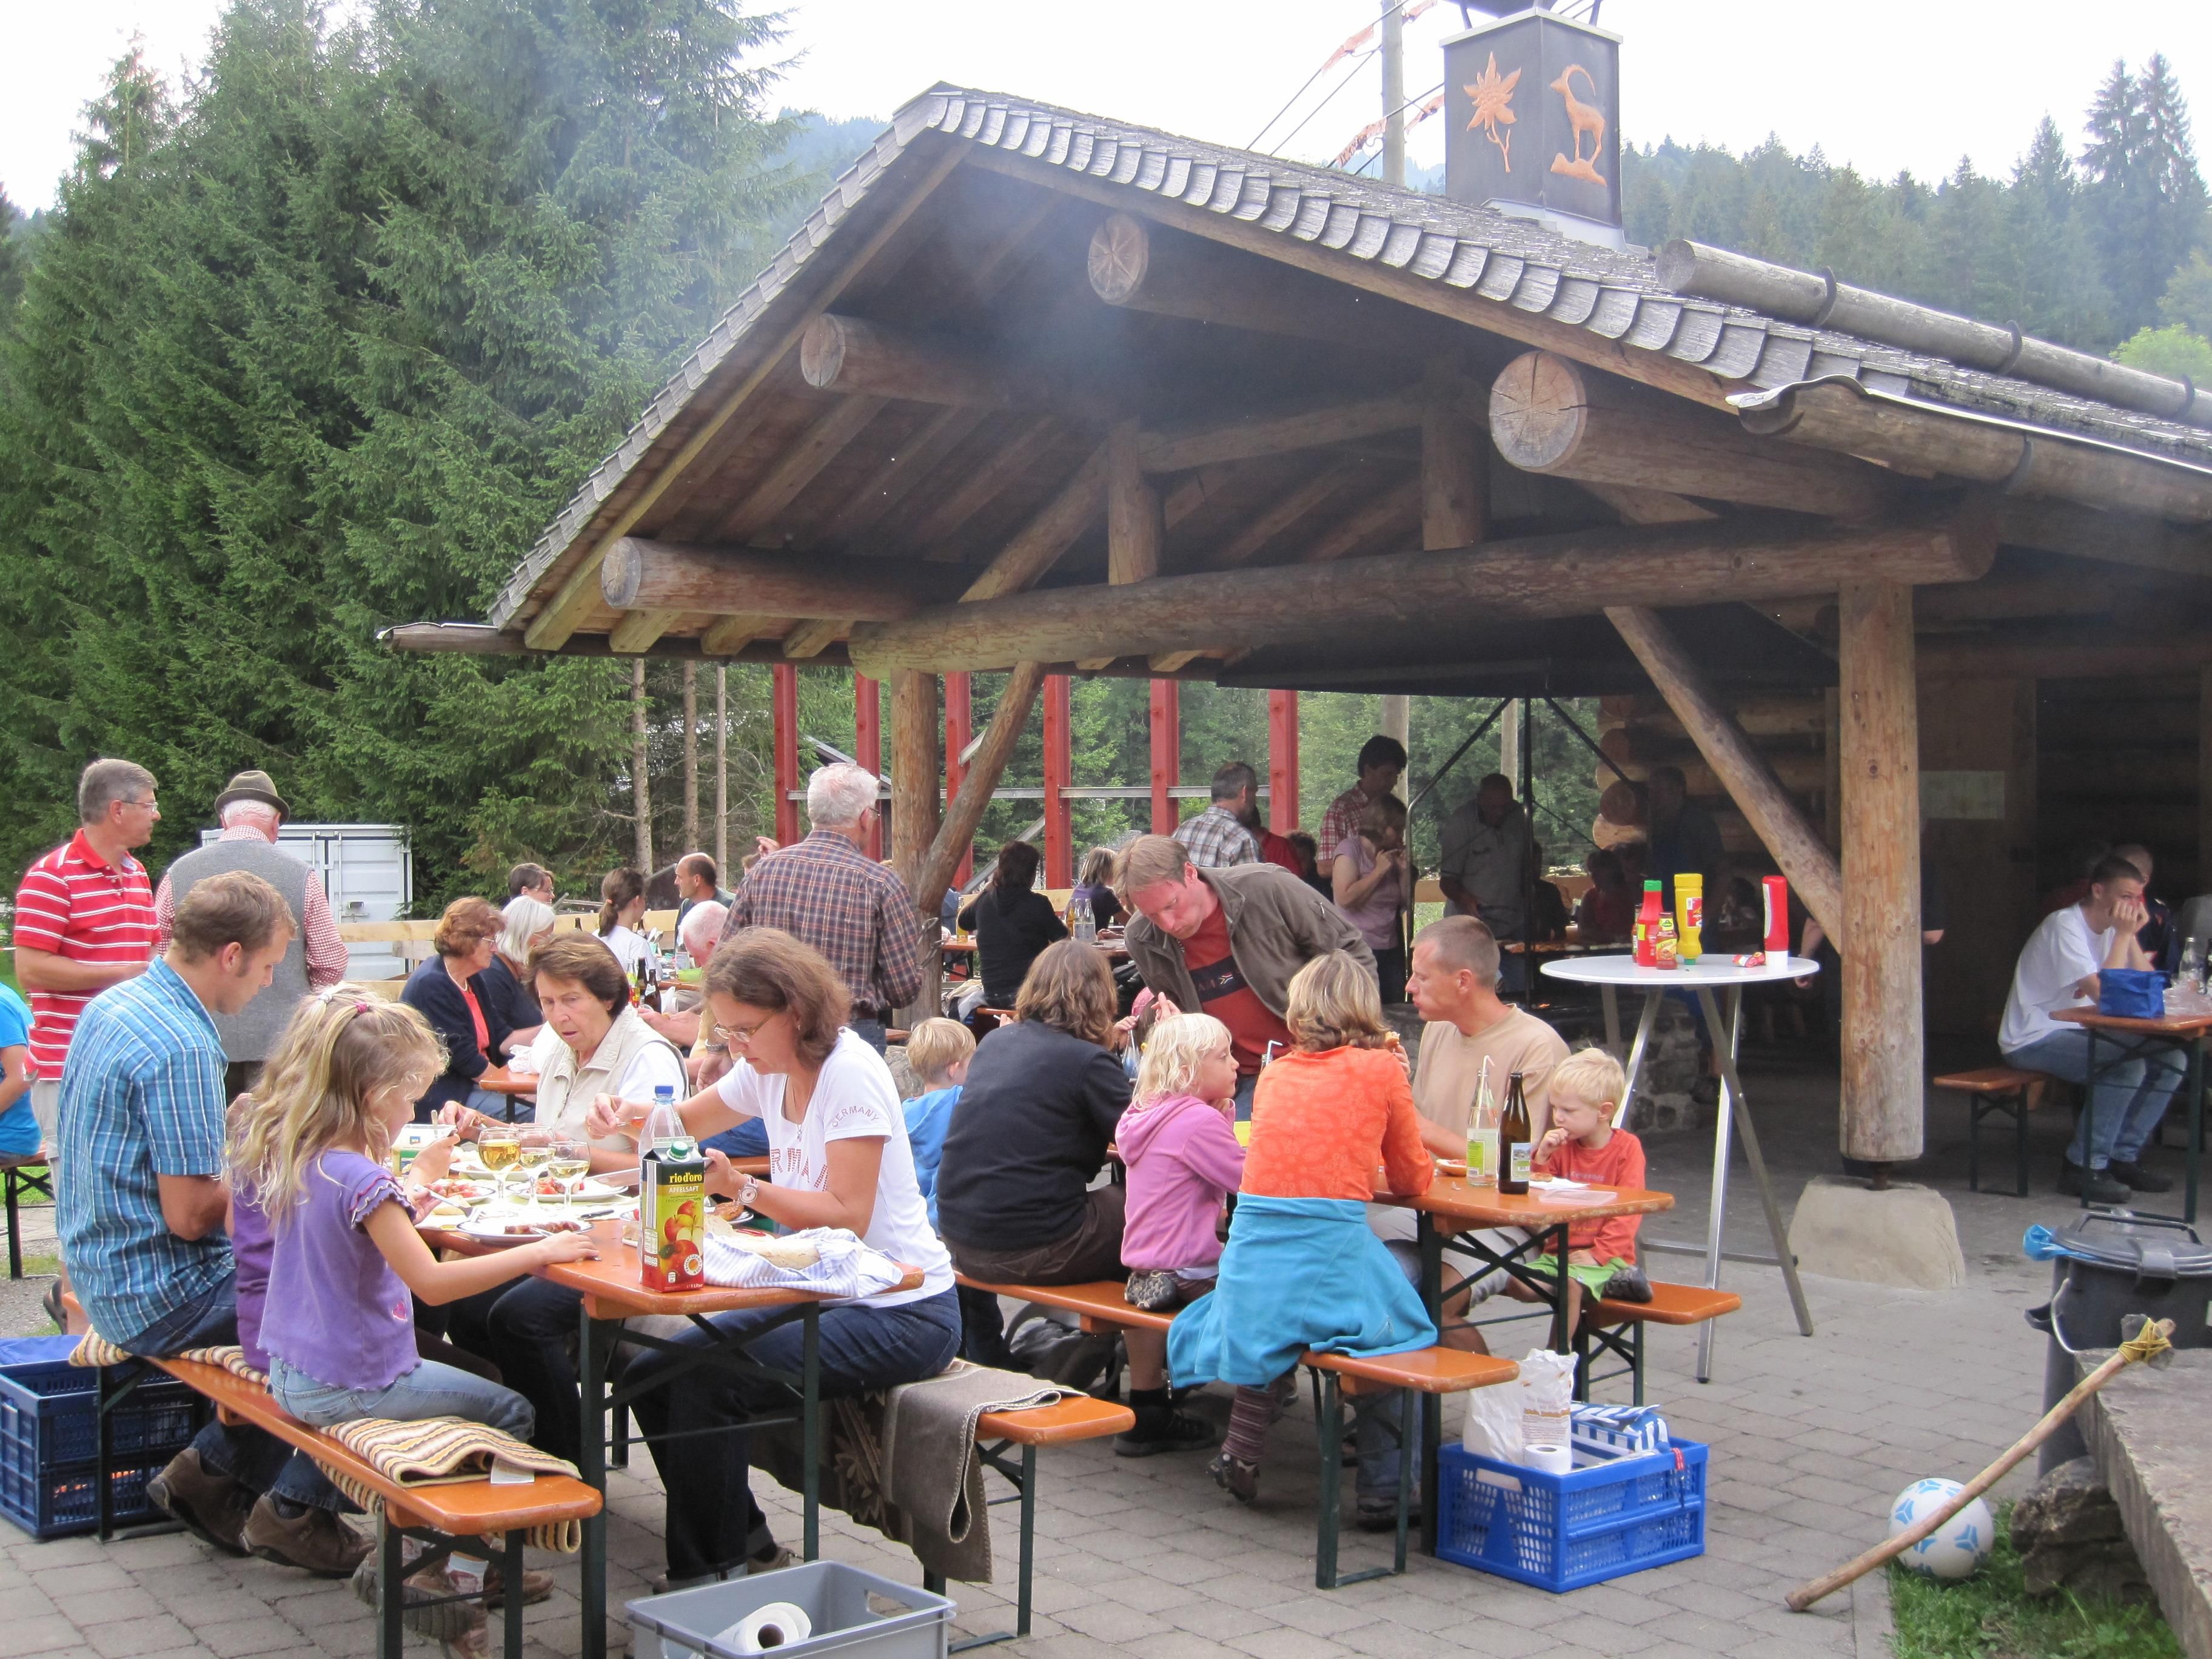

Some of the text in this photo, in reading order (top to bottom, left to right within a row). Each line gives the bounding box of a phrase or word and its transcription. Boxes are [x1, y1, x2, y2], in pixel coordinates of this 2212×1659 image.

[833, 1105, 879, 1127] GERMANY
[669, 1172, 702, 1184] rio d'oro
